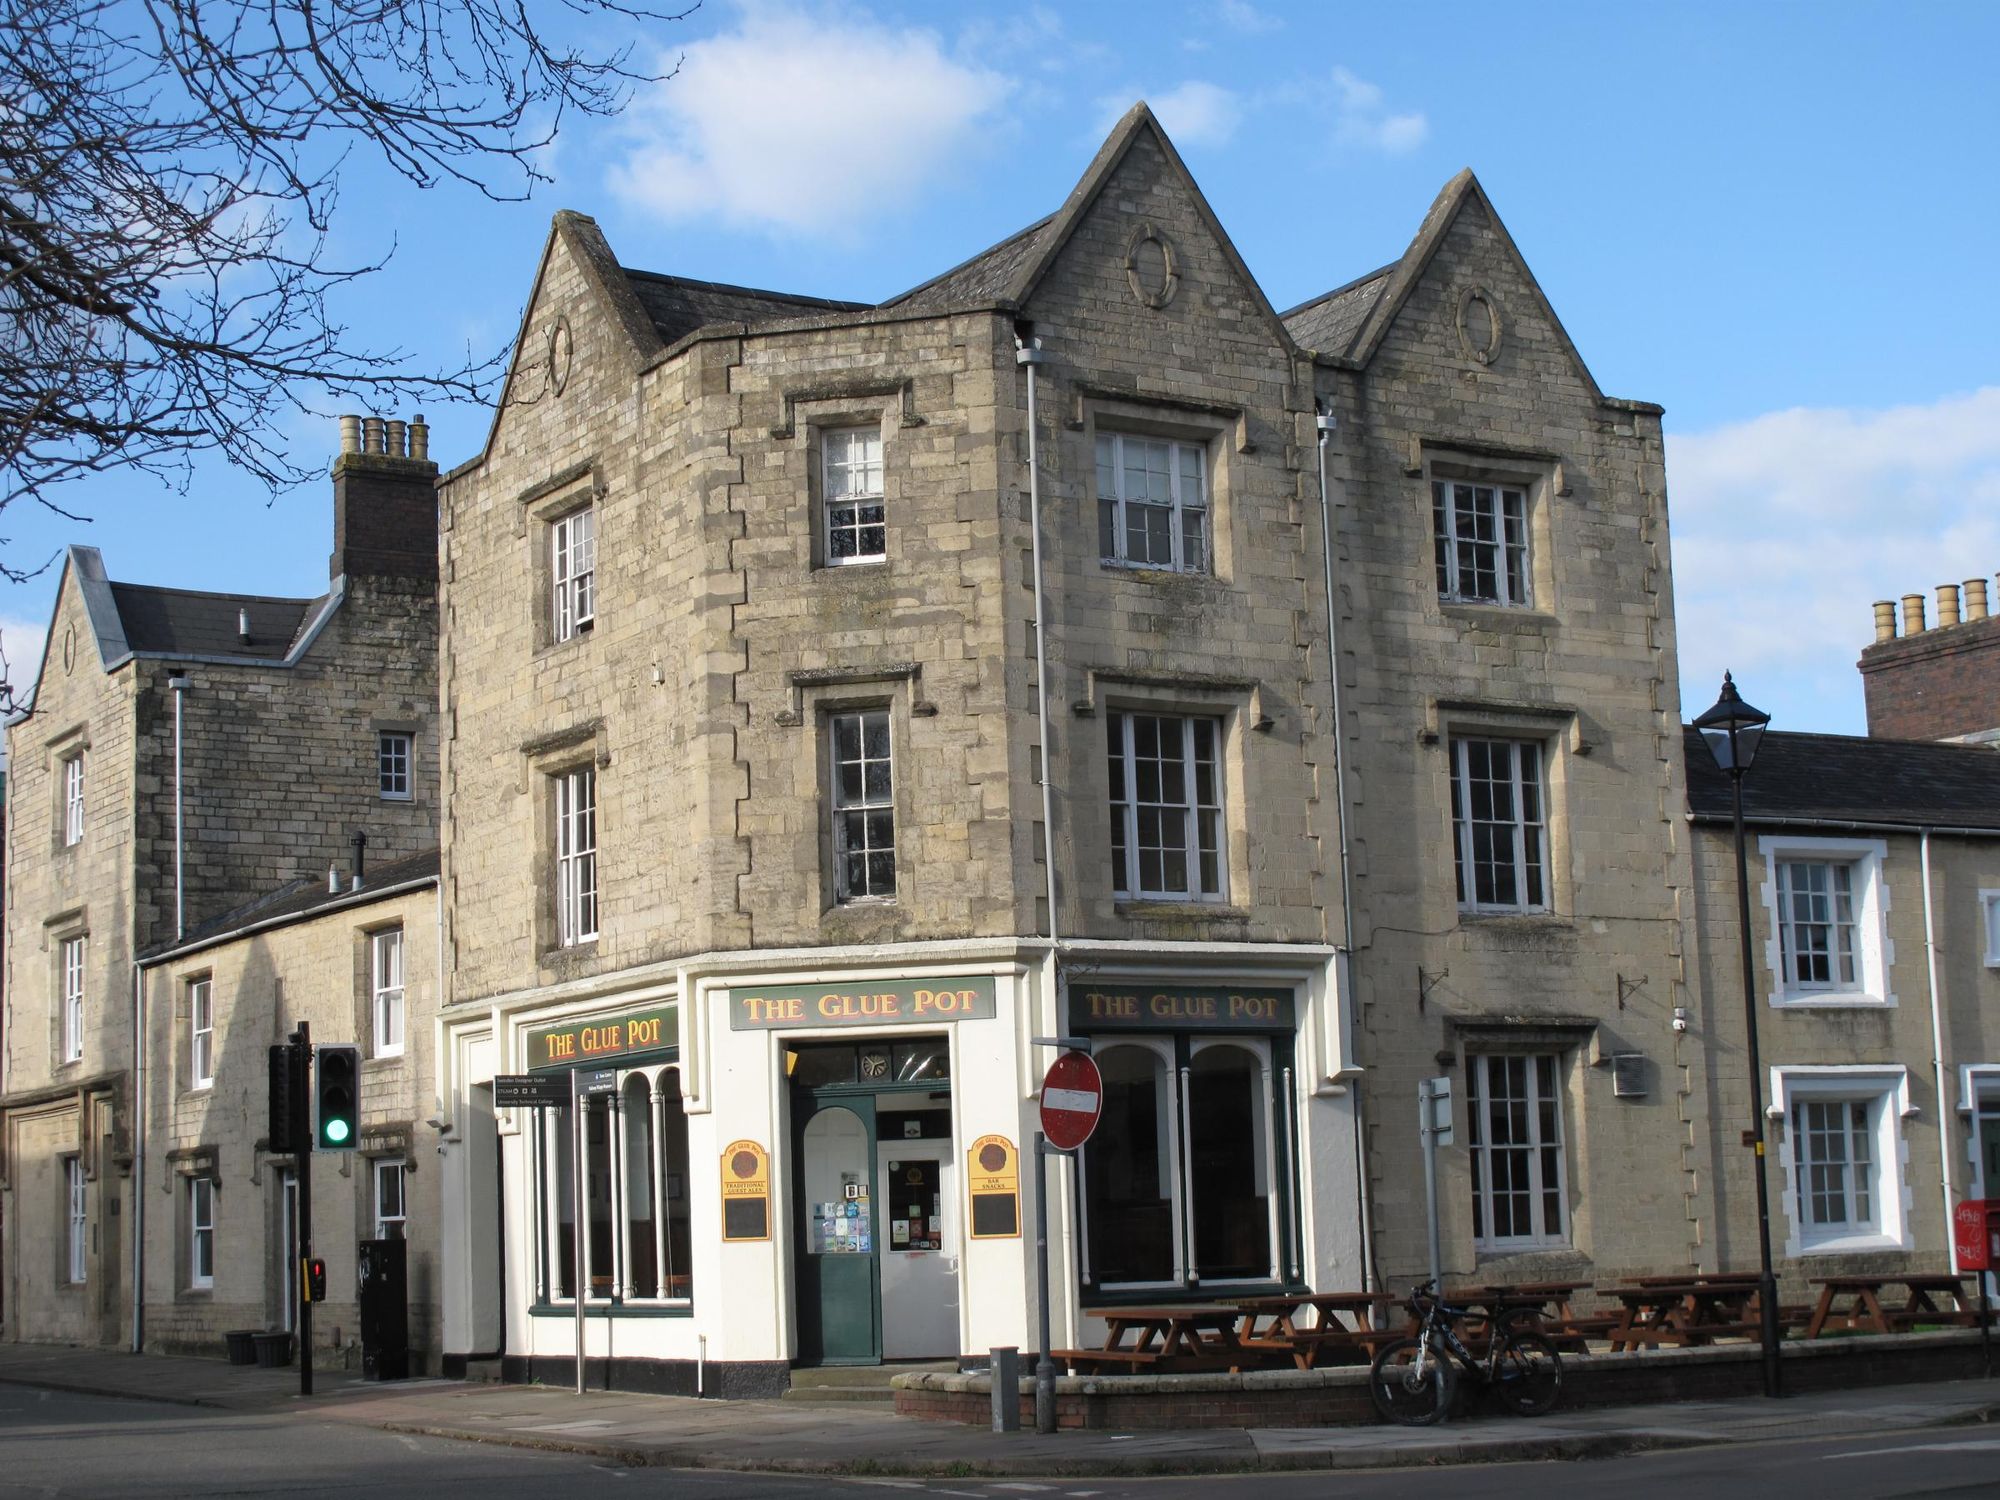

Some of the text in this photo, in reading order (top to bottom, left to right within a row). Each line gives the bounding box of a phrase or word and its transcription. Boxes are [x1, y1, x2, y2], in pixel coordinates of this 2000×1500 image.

[743, 990, 977, 1021] THE GLUE POT
[1086, 993, 1279, 1019] THE GLUE POT
[545, 1018, 661, 1059] THE GLUE POT
